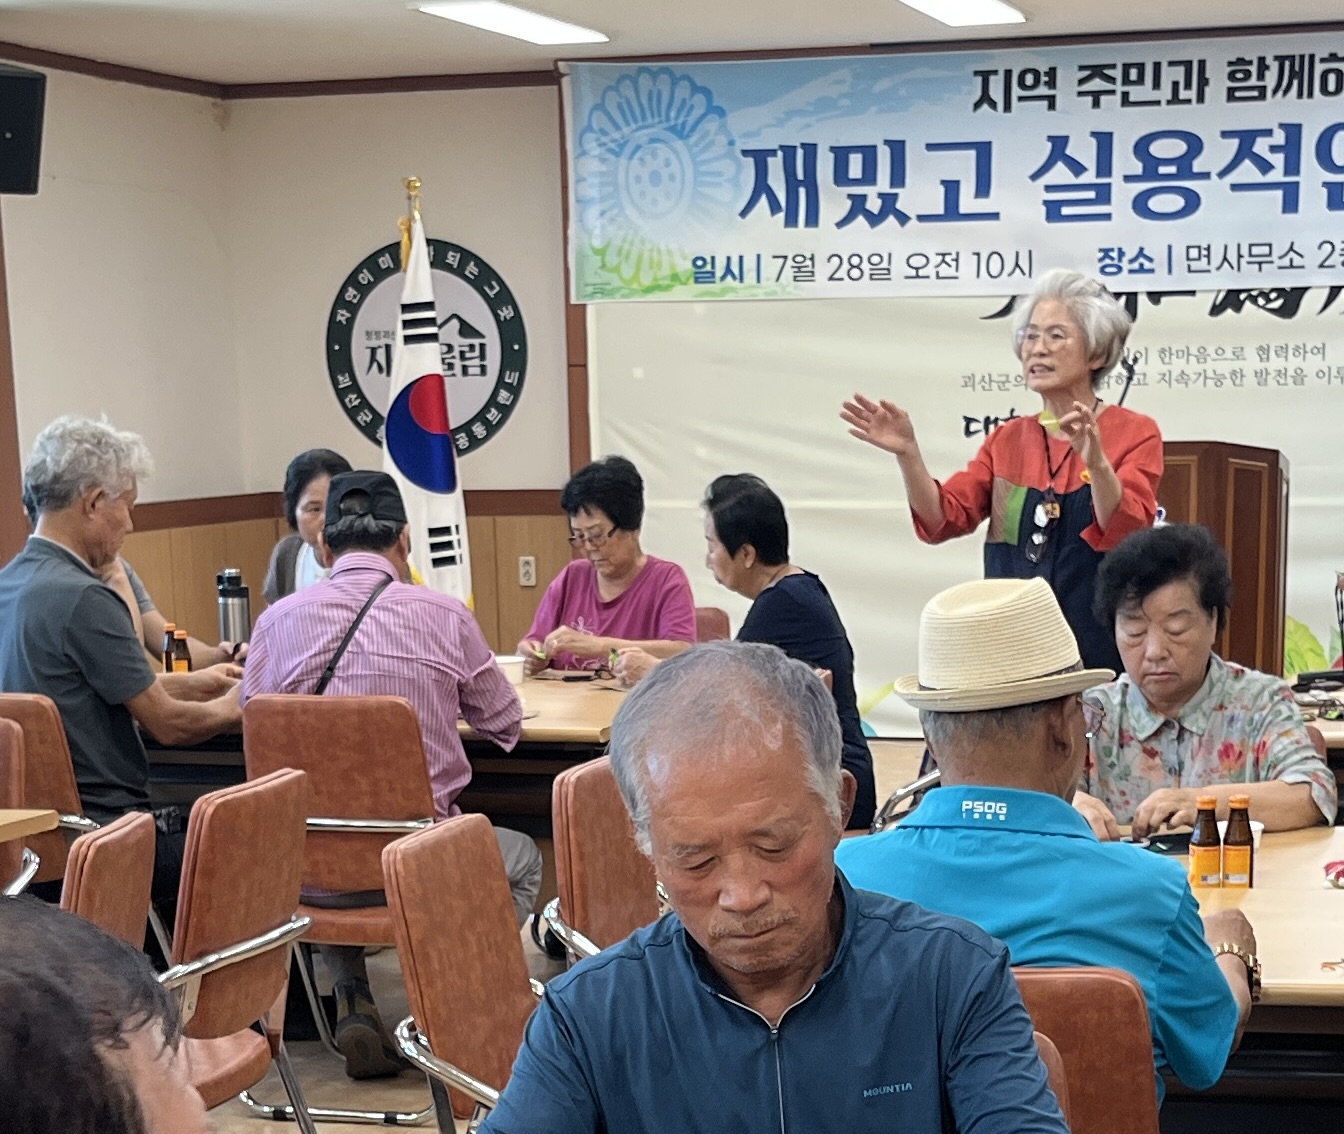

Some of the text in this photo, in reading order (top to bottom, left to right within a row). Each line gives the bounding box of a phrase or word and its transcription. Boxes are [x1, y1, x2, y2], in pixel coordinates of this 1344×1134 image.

[972, 66, 1058, 114] 지역
[1075, 59, 1210, 109] 주민과
[738, 138, 1002, 229] 재밌고
[691, 248, 1035, 284] 일시 7월 28일 오전 10시
[1097, 244, 1157, 276] 장소
[1185, 239, 1306, 275] 면사무소
[1157, 345, 1247, 365] 한마음으로
[1255, 343, 1327, 362] 협력하여
[1157, 370, 1246, 389] 지속가능한
[1254, 367, 1308, 387] 발전을
[863, 1082, 913, 1098] MOUNTIA
